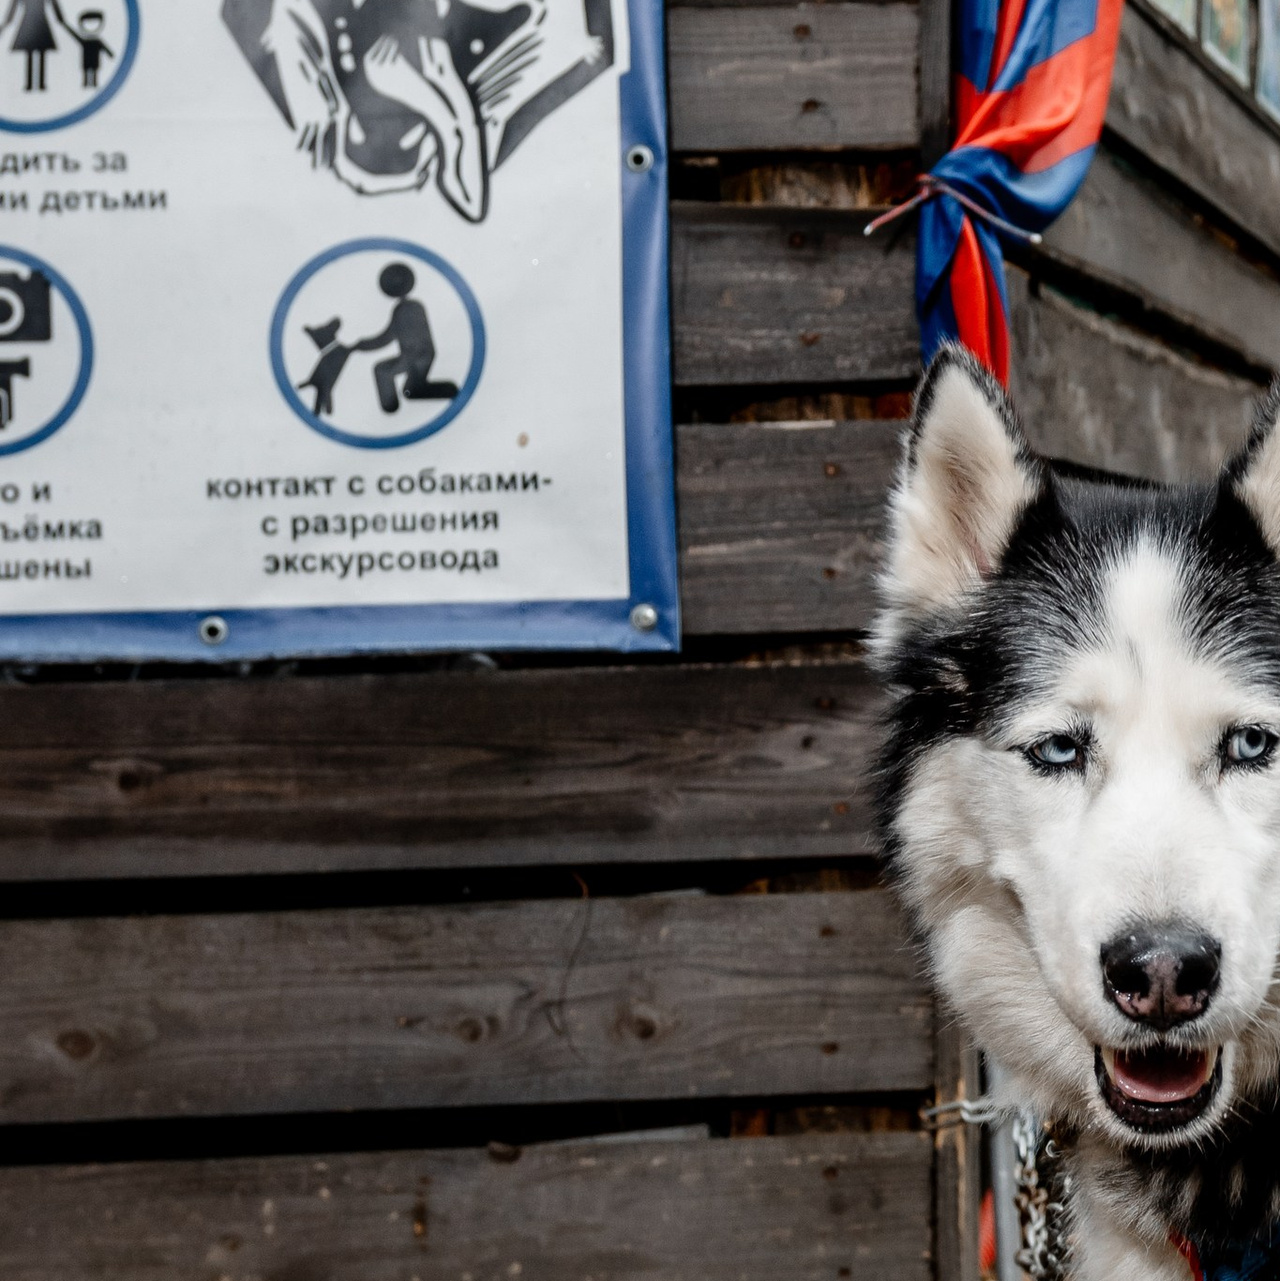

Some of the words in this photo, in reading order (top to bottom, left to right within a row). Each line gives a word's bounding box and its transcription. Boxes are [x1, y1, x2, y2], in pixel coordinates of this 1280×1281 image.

[93, 152, 128, 172] за
[39, 190, 168, 215] детьми
[32, 481, 52, 502] и
[205, 475, 336, 500] контакт
[346, 474, 366, 497] с
[375, 467, 553, 496] собаками-
[259, 516, 279, 537] с
[289, 510, 500, 540] разрешения
[263, 549, 500, 579] экскурсовода
